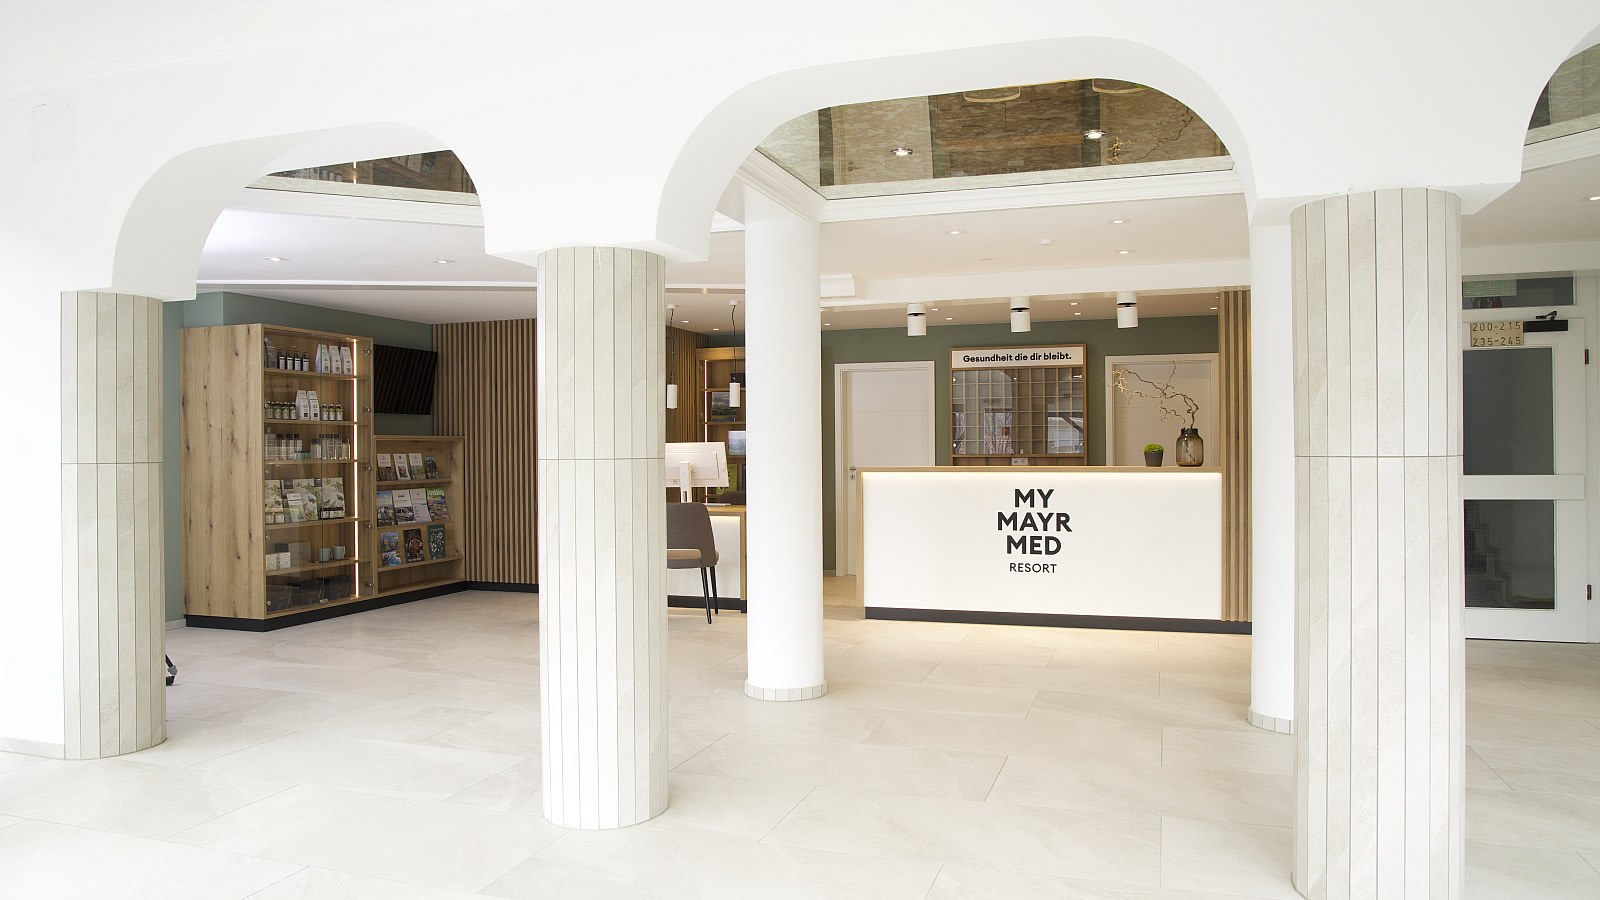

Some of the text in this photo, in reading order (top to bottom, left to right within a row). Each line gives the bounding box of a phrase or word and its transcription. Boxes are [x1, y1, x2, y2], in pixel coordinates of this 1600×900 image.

[1472, 321, 1521, 332] 200-215
[1472, 337, 1521, 347] 235-245
[963, 352, 1072, 363] Gesundheit die dir bleibt.
[1014, 489, 1055, 508] MY
[997, 511, 1072, 532] MAYR
[1006, 535, 1061, 555] MED
[1009, 562, 1057, 573] RESORT
